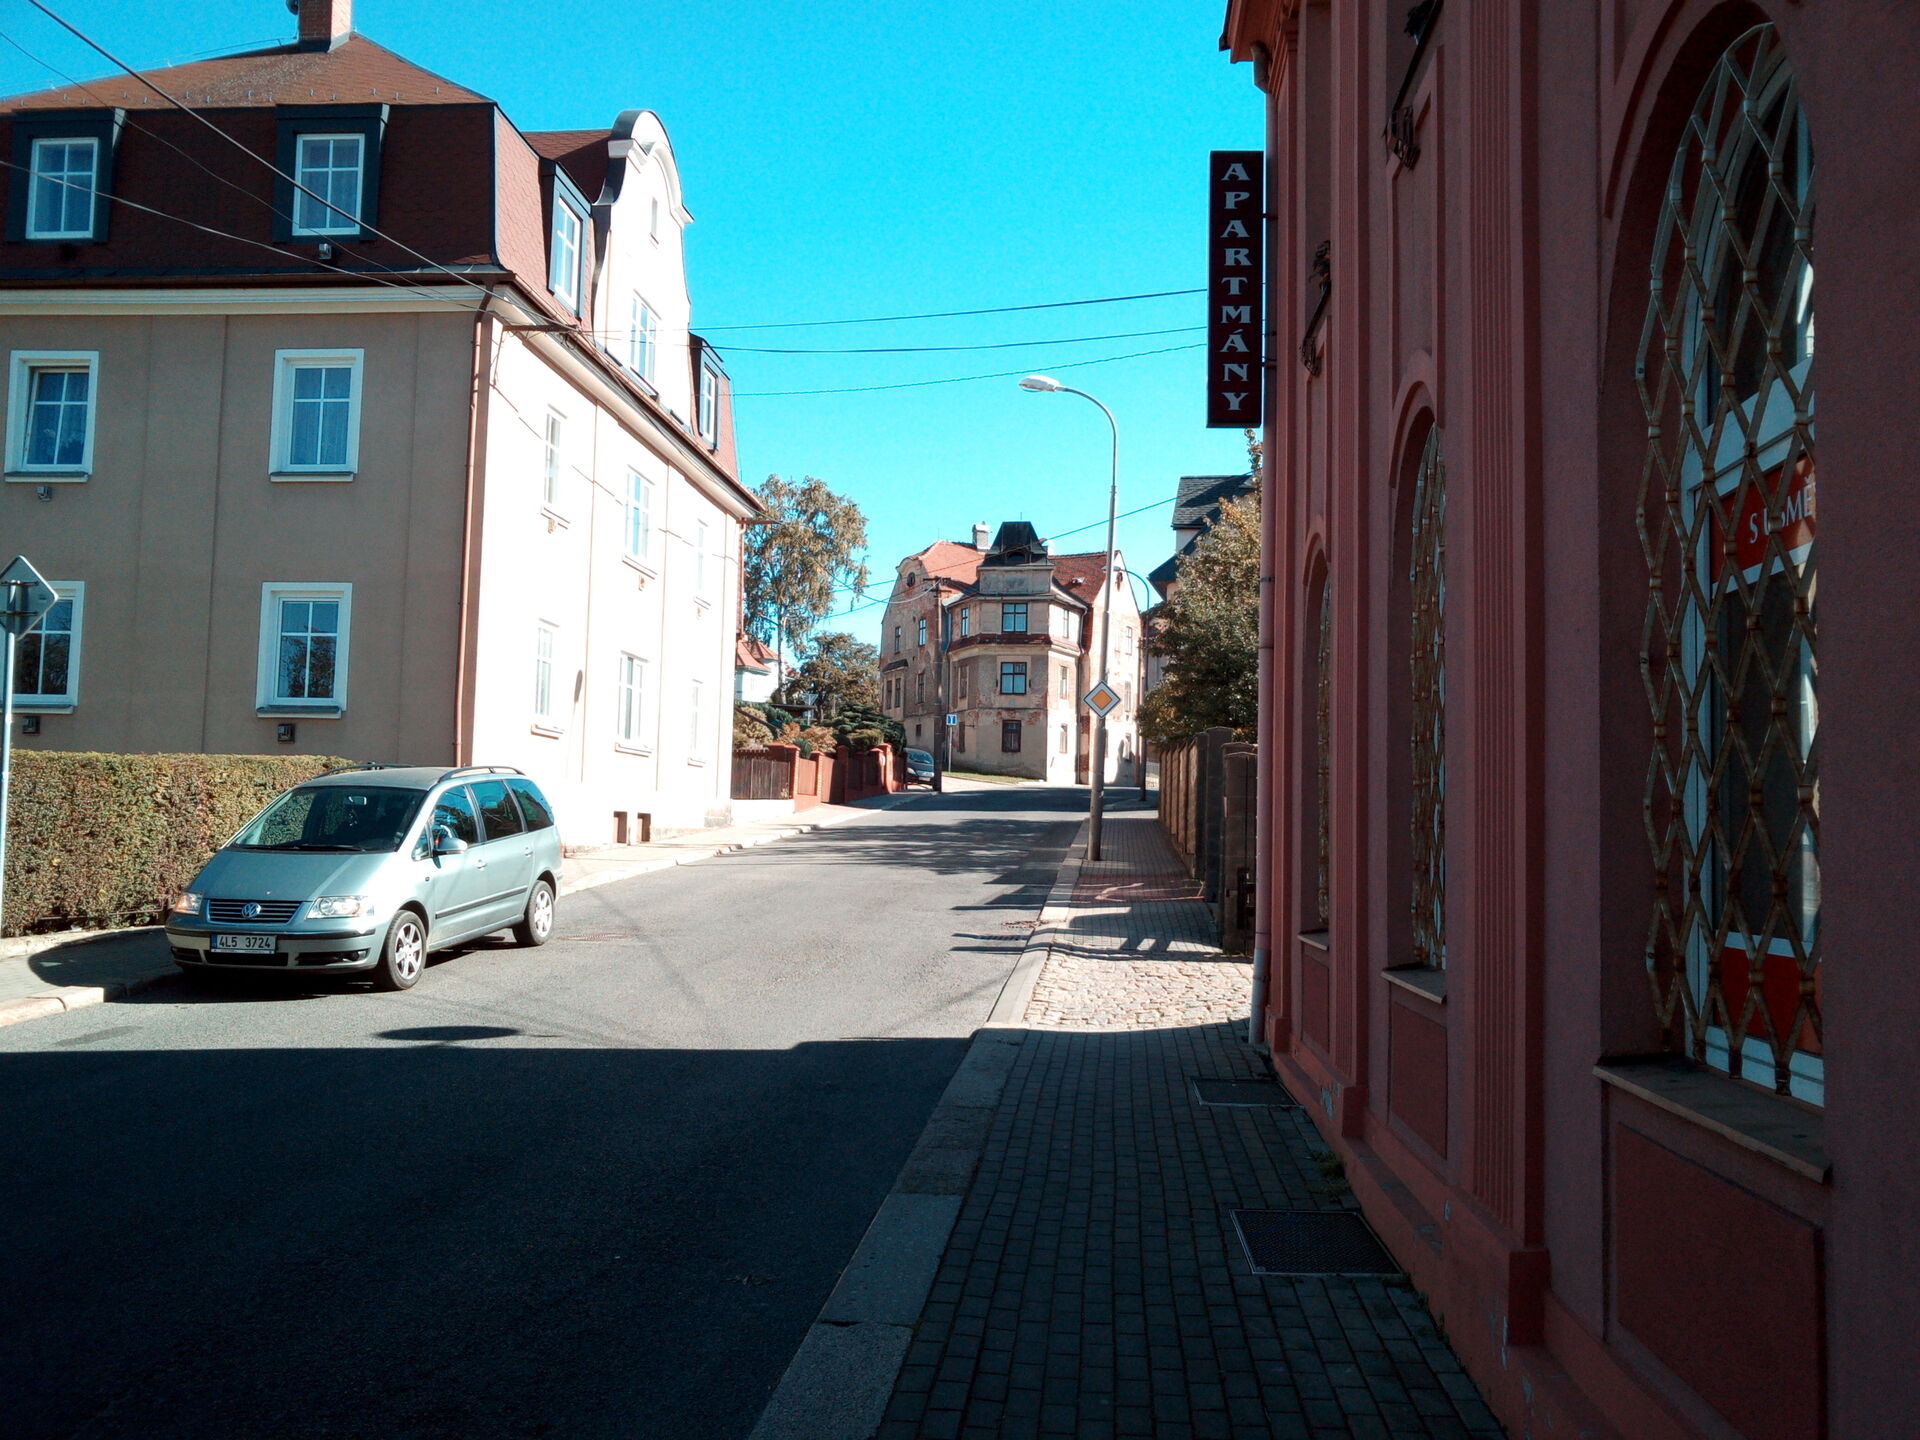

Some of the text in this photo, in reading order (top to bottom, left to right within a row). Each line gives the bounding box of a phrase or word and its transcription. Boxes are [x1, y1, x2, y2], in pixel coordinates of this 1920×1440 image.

[1220, 162, 1253, 411] APARTMÁNY
[219, 935, 271, 949] 4L5 3724
